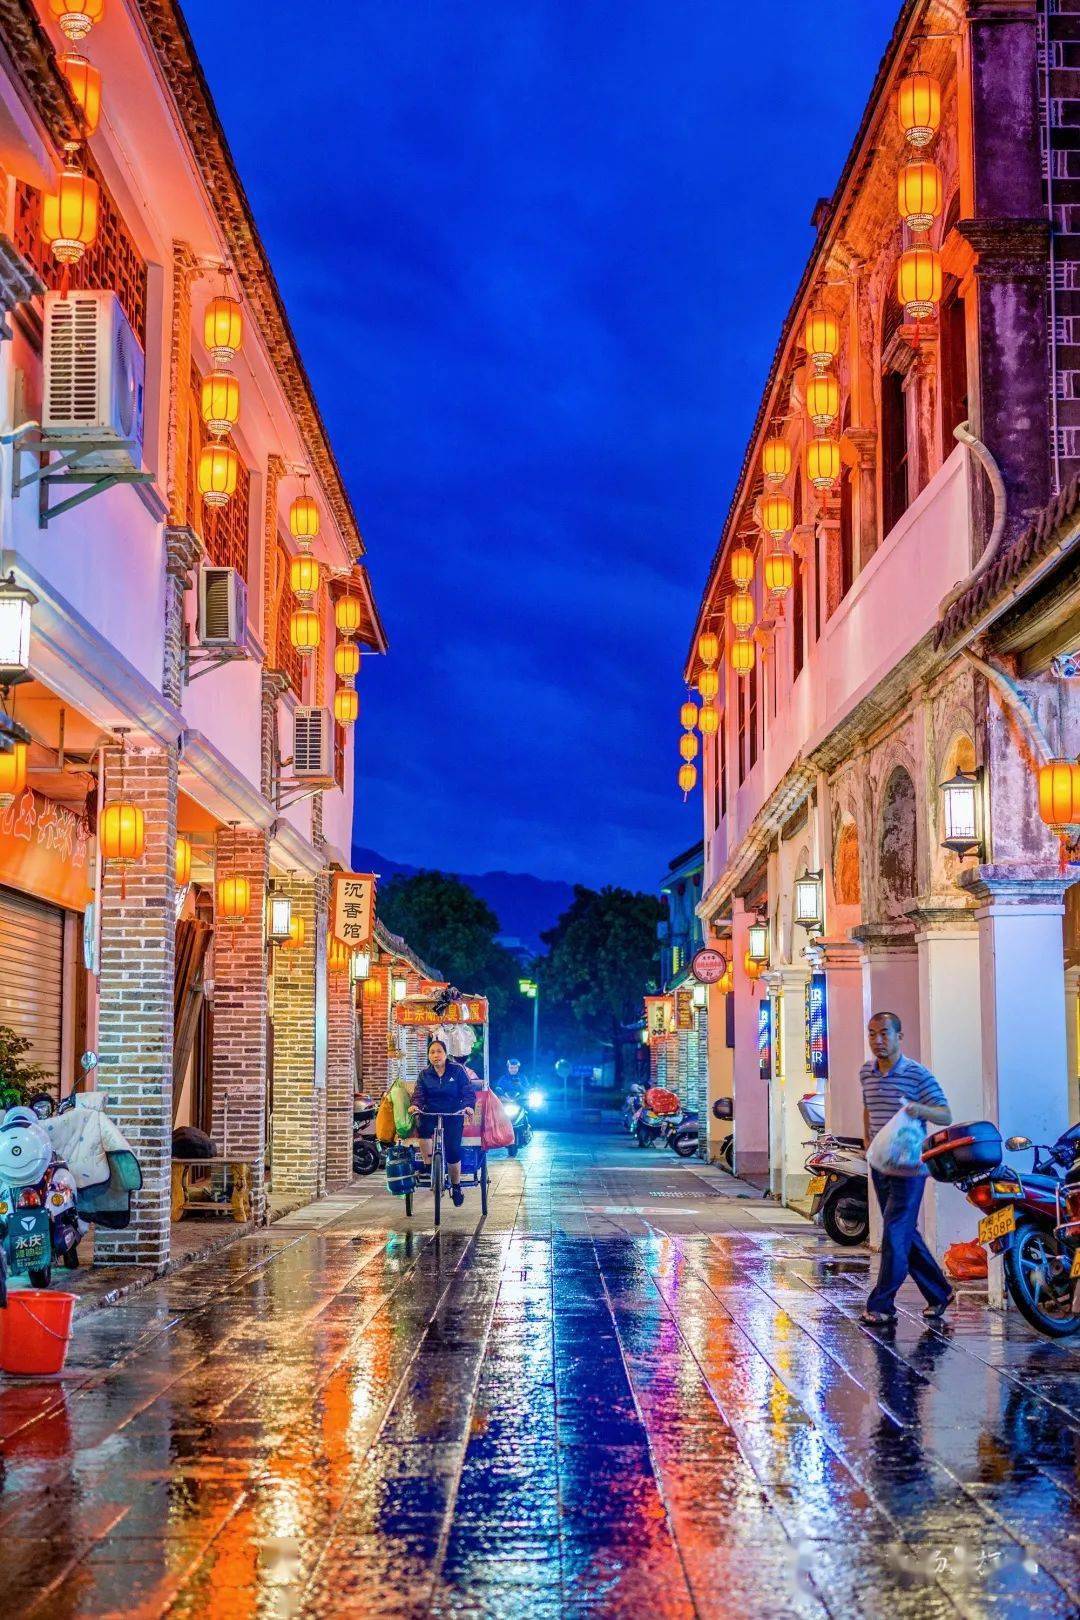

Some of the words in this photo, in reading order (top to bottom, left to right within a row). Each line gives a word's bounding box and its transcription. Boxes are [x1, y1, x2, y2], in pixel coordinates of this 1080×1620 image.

[343, 882, 364, 939] 沉香馆
[16, 1234, 42, 1249] 永庆
